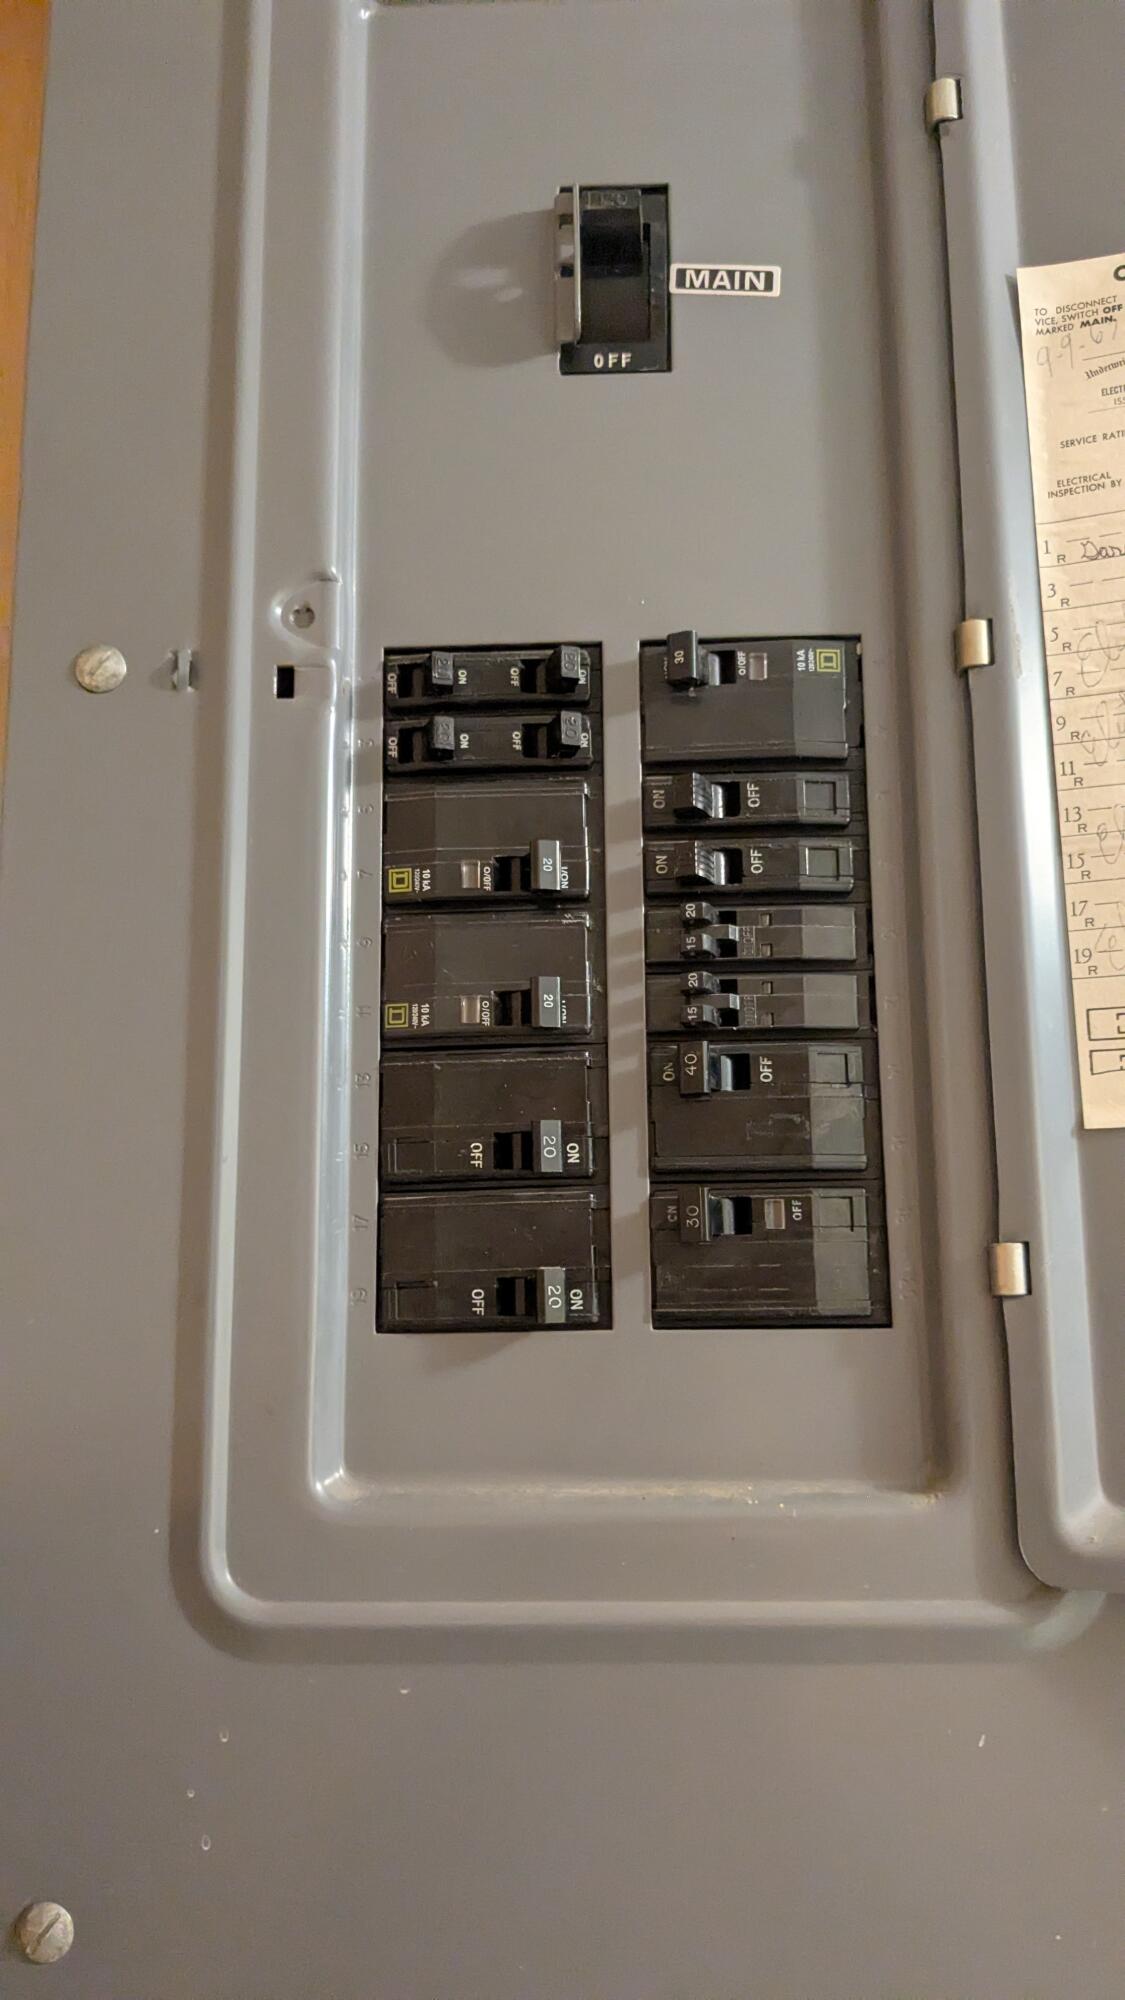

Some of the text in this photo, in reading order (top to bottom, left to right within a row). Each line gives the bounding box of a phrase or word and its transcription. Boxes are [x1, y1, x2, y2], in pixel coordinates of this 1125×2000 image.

[685, 269, 765, 291] MAIN
[1034, 295, 1117, 317] TO DISCONNECT
[1061, 309, 1099, 323] SWITCH
[1102, 303, 1124, 314] OFF
[1035, 315, 1117, 336] MARKED MAIN.
[594, 352, 632, 369] OFF
[1059, 434, 1097, 449] SERVICE
[1047, 479, 1122, 499] INSPECTION BY
[1056, 472, 1112, 488] ELECTRICAL
[1043, 540, 1066, 564] 1 R
[1047, 583, 1070, 607] 3 R
[1050, 627, 1072, 652] 5 R
[674, 650, 685, 665] 30
[796, 661, 806, 672] 10
[387, 672, 398, 696] OFF
[457, 669, 468, 685] ON
[510, 667, 520, 687] OFF
[579, 669, 588, 685] ON
[1053, 671, 1075, 696] 7 R
[1056, 716, 1080, 741] 9 R
[387, 736, 398, 759] OFF
[459, 733, 470, 749] ON
[512, 731, 522, 750] OFF
[580, 732, 589, 748] ON
[1059, 761, 1084, 787] 11 R
[652, 789, 665, 809] ON
[747, 782, 760, 808] OFF
[1064, 806, 1088, 833] 13 R
[542, 857, 553, 872] 20
[655, 855, 668, 874] ON
[751, 849, 763, 874] OFF
[1067, 853, 1091, 880] 15 R
[421, 868, 431, 879] 10
[685, 903, 696, 919] 20
[1071, 900, 1095, 928] 17 R
[686, 936, 696, 950] 15
[1074, 948, 1098, 975] 19 R
[688, 973, 698, 988] 20
[420, 1003, 431, 1014] 10
[543, 994, 553, 1008] 20
[687, 1006, 697, 1020] 15
[662, 1061, 675, 1081] ON
[684, 1053, 697, 1076] 40
[760, 1056, 773, 1083] OFF
[470, 1143, 483, 1168] OFF
[543, 1136, 556, 1158] 20
[566, 1143, 580, 1163] ON
[686, 1205, 700, 1228] 30
[792, 1199, 802, 1221] OFF
[471, 1289, 485, 1316] OFF
[548, 1285, 561, 1309] 20
[569, 1289, 583, 1310] ON
